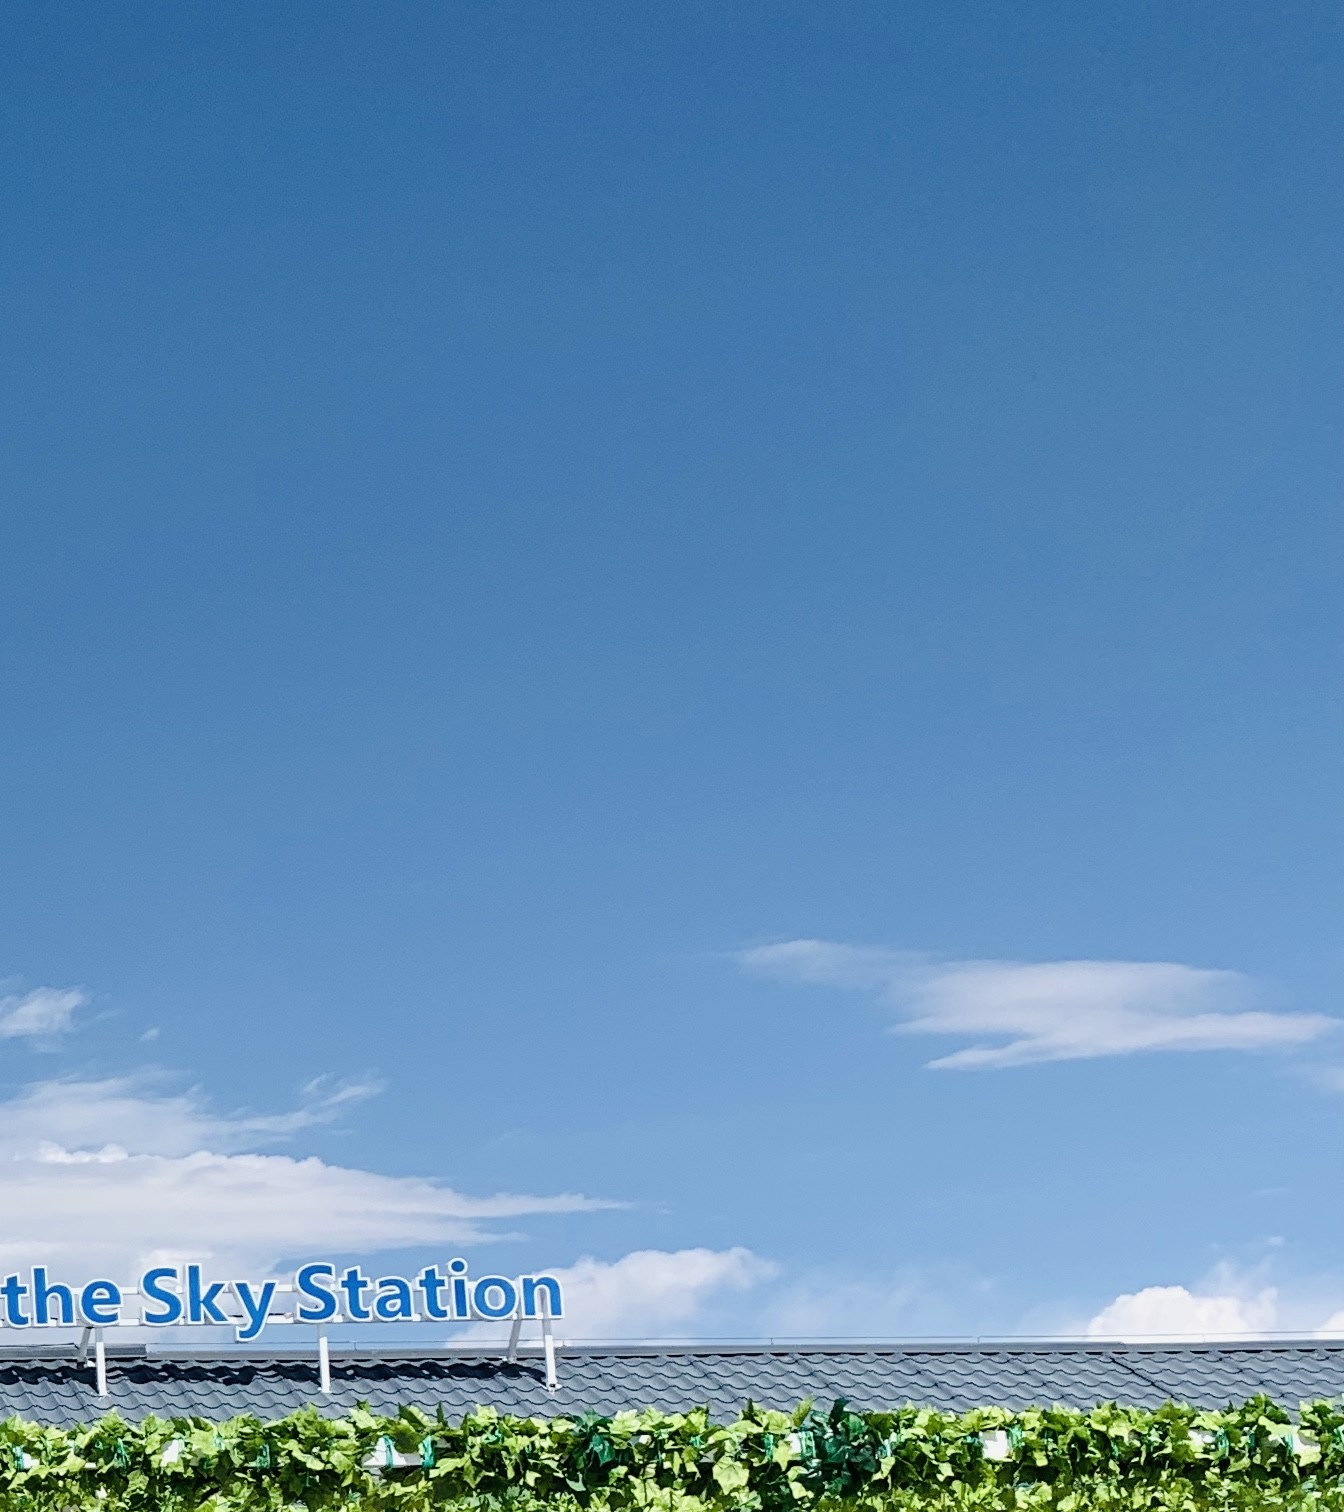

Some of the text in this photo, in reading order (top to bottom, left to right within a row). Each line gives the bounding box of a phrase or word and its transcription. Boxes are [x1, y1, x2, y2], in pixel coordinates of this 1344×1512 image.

[0, 1268, 121, 1325] the
[143, 1265, 275, 1339] Sky
[298, 1260, 562, 1320] Station
